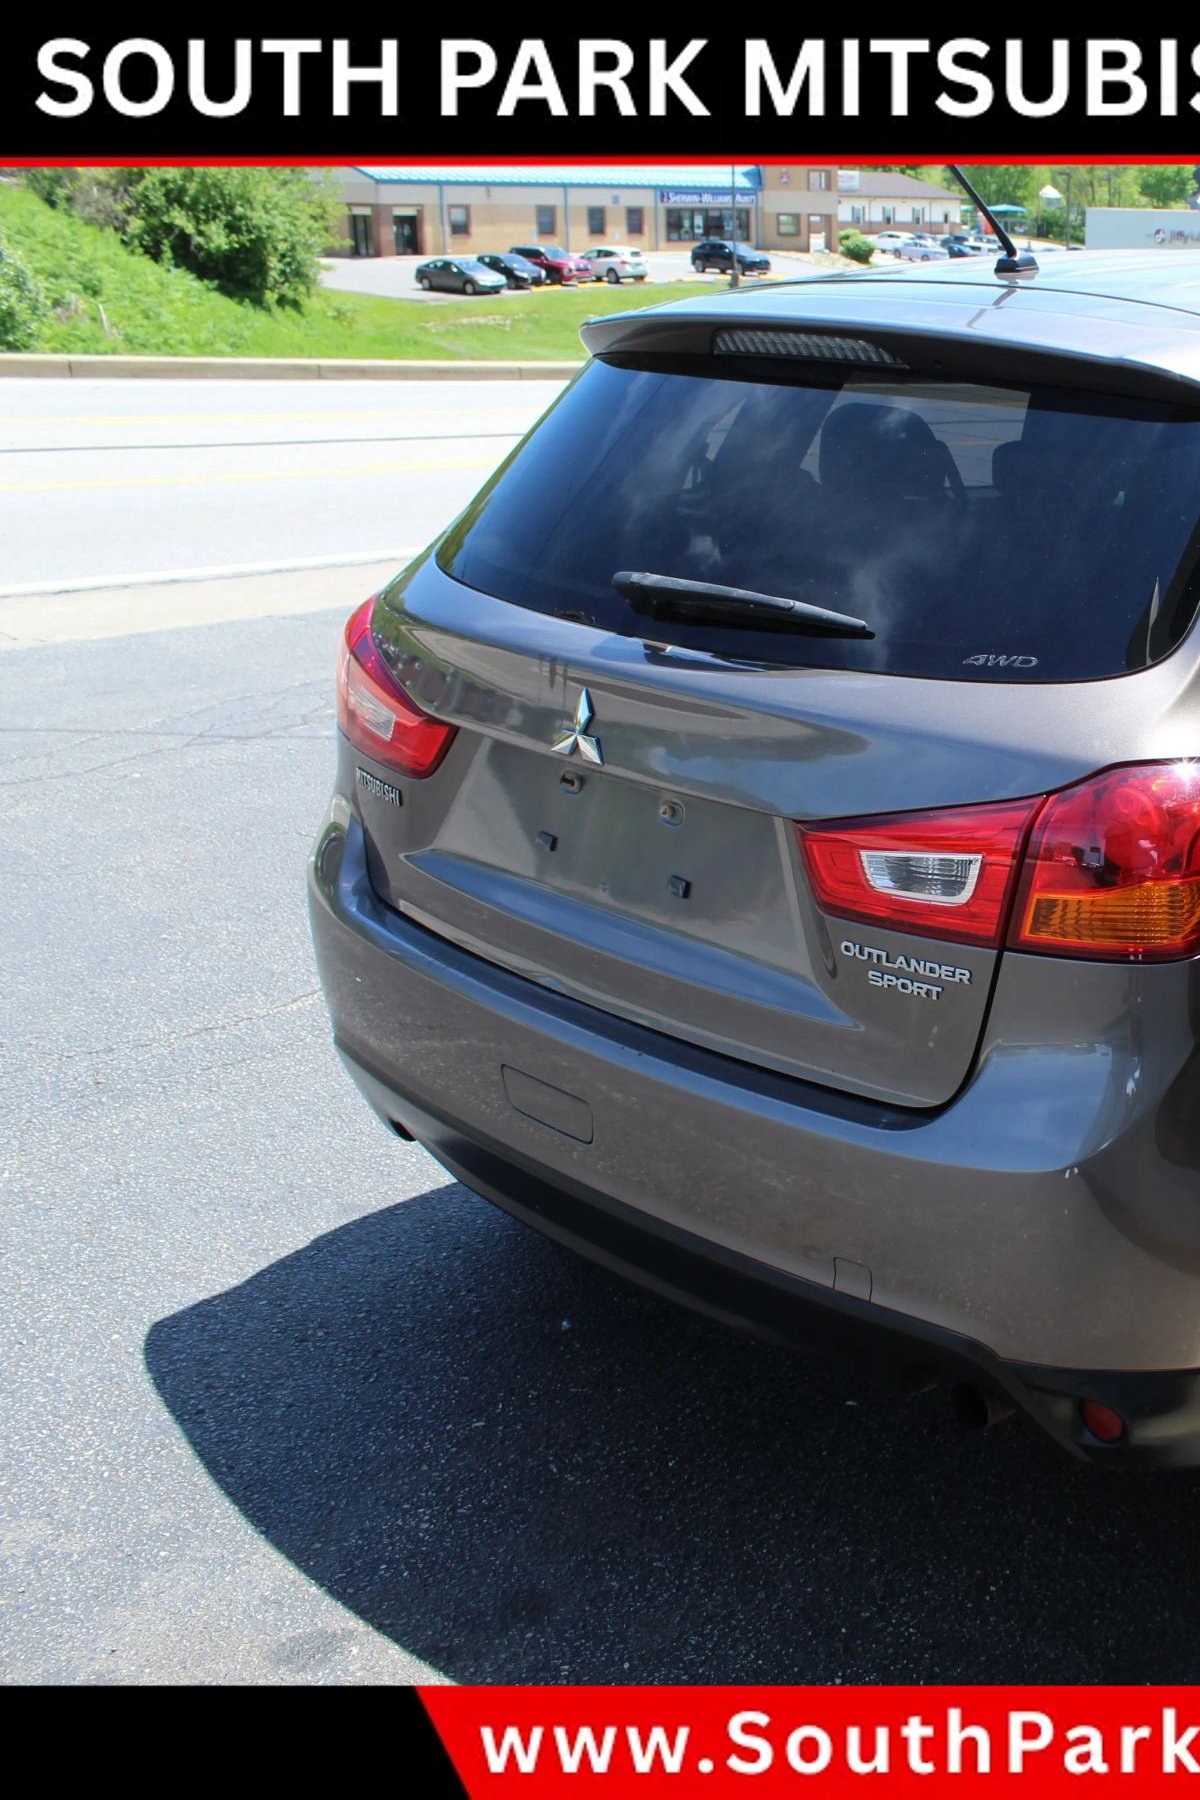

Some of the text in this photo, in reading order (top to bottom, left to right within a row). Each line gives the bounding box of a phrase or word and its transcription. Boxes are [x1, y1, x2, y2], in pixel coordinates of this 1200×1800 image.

[962, 653, 1039, 668] 4WD
[355, 767, 402, 807] MITSUBISHI
[840, 940, 972, 985] OUTLANDER
[868, 970, 943, 1001] SPORT
